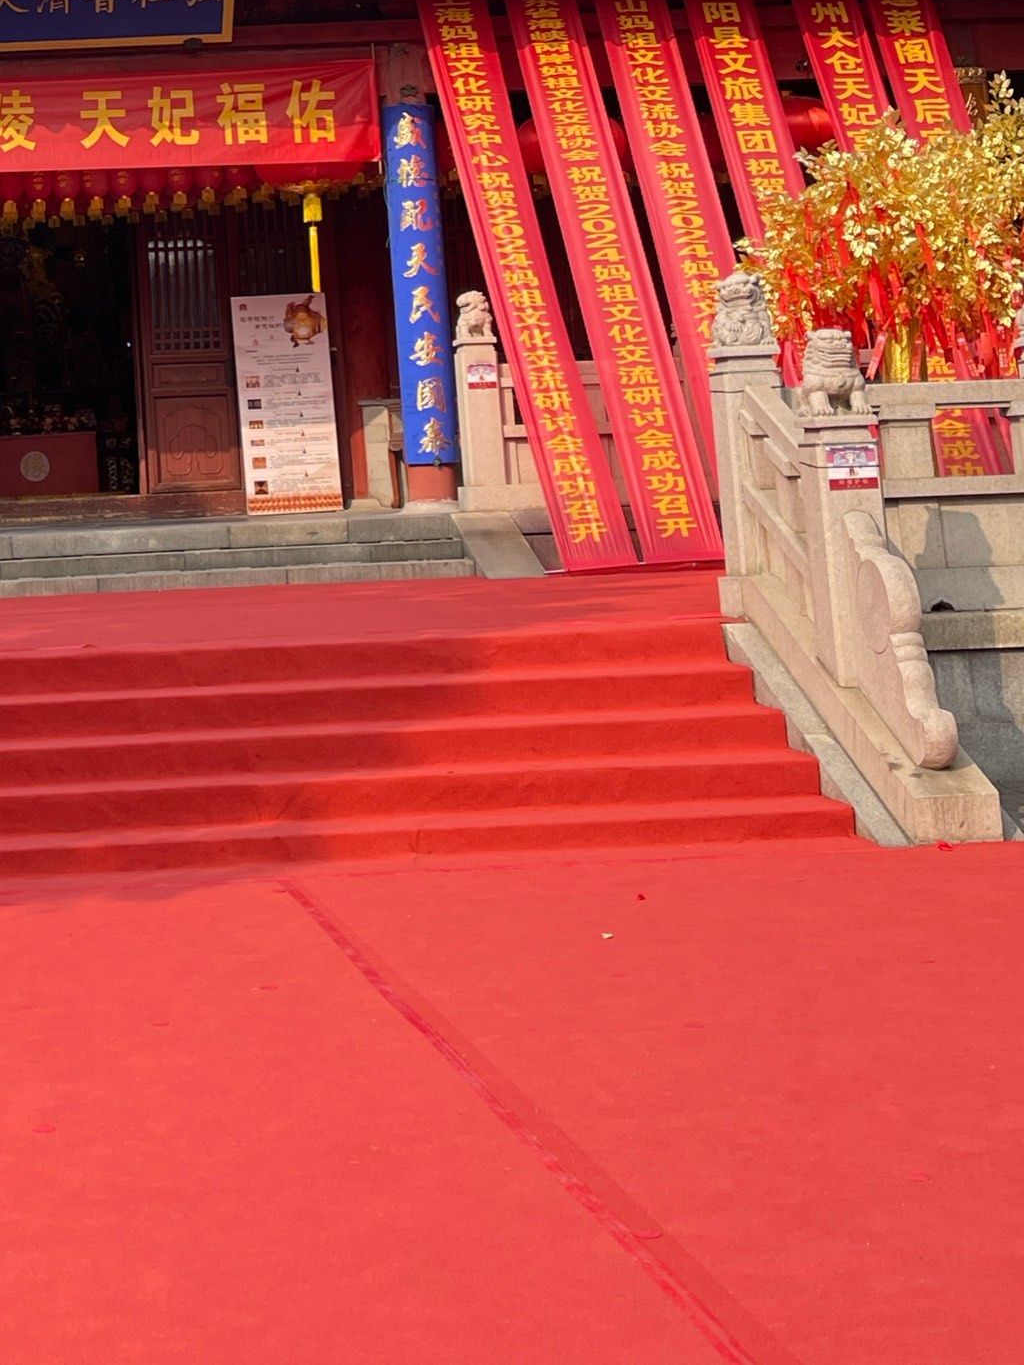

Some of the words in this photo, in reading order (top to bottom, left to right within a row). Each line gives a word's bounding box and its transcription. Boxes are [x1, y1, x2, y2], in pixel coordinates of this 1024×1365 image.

[79, 79, 337, 150] 天妃福佑
[477, 172, 608, 544] 祝贺2024妈祖文化交流研讨会成功召开
[567, 166, 698, 539] 祝贺2024妈祖文化交流研讨会成功召开
